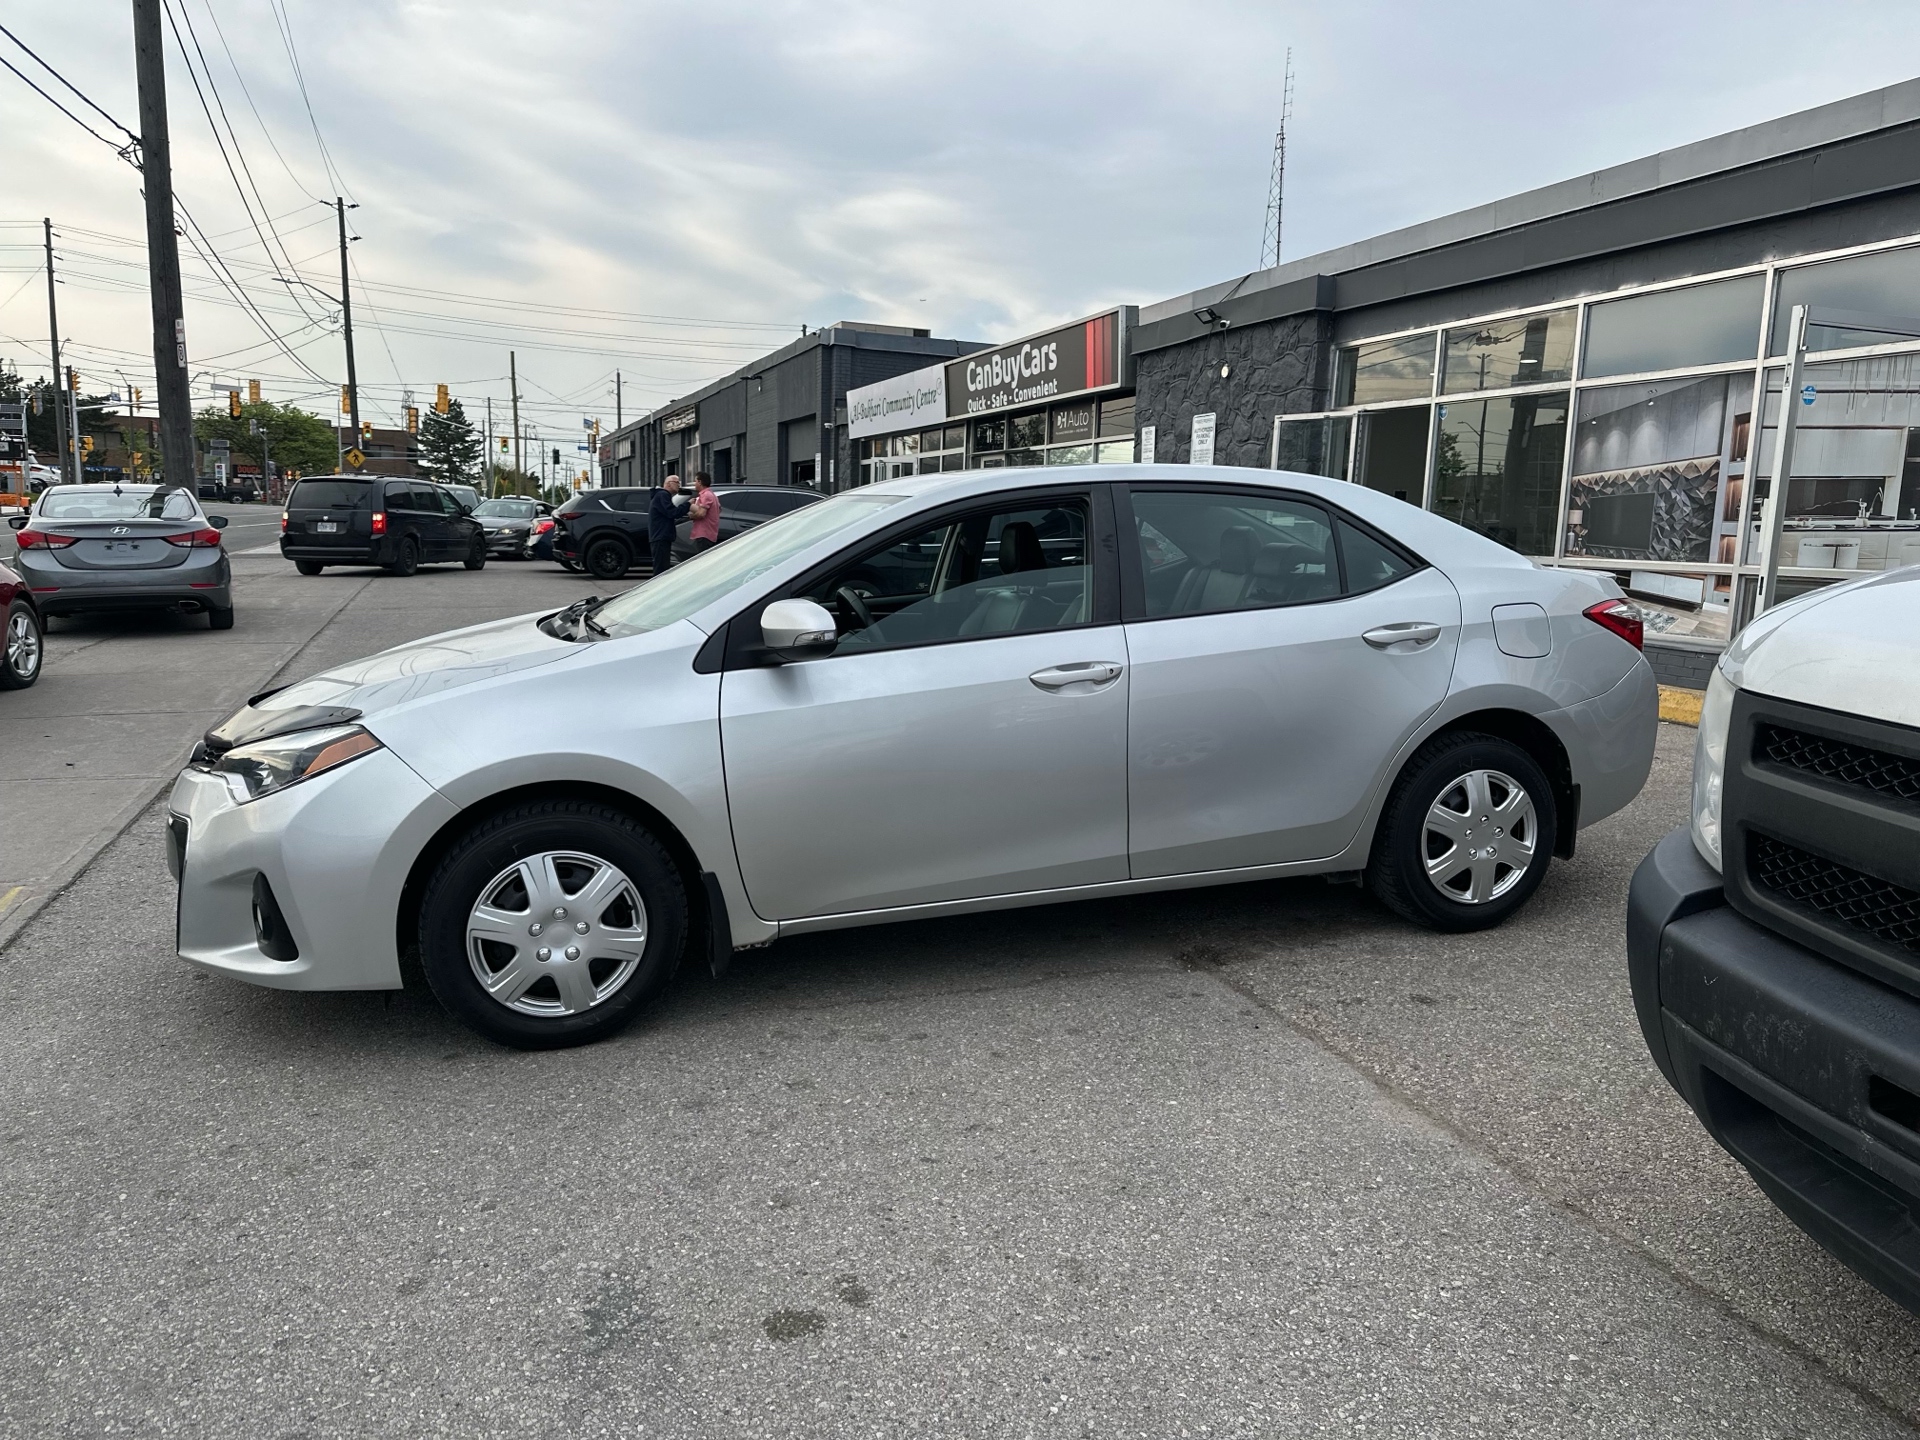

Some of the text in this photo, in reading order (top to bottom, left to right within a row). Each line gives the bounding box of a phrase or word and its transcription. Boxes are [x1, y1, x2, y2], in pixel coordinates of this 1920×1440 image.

[967, 342, 1058, 392] CanBuyCars
[882, 390, 915, 417] Community
[916, 388, 937, 410] Centre
[967, 395, 987, 413] Quick
[991, 390, 1008, 408] Safe
[1013, 378, 1058, 403] Convenient
[1067, 410, 1089, 427] Auto
[1197, 438, 1209, 446] ONLY
